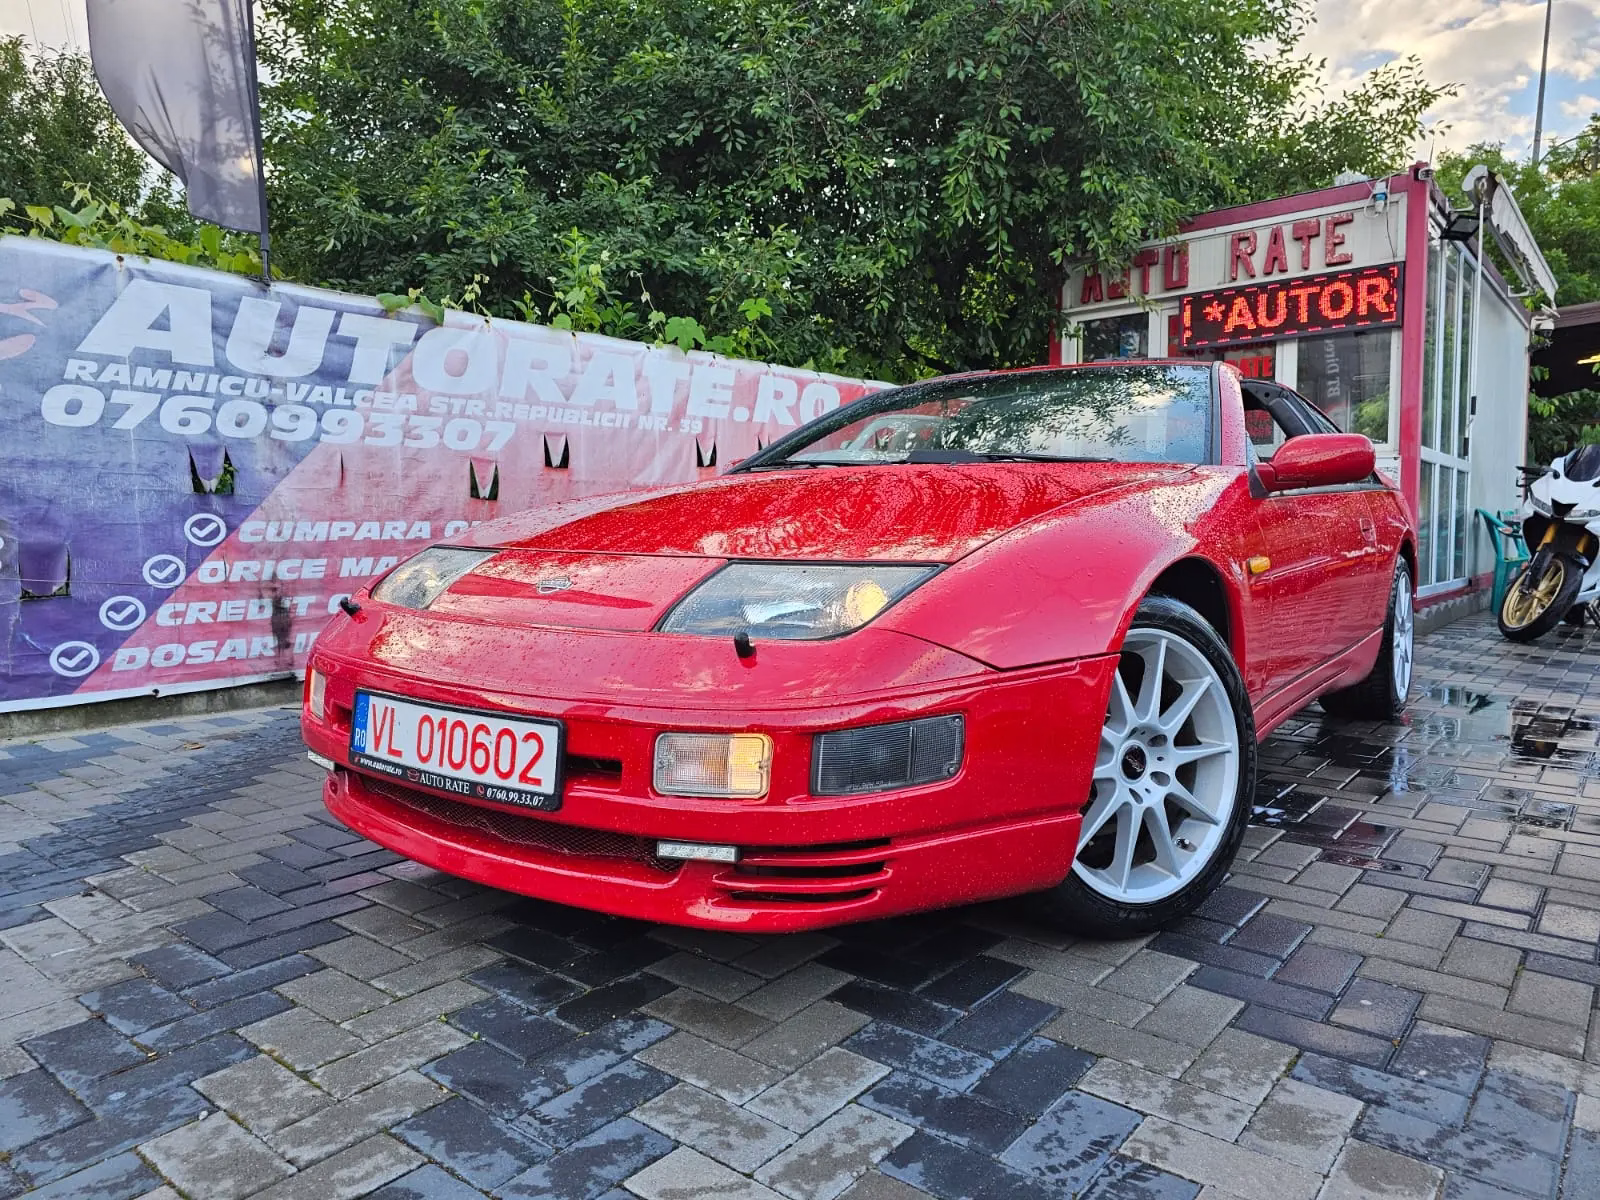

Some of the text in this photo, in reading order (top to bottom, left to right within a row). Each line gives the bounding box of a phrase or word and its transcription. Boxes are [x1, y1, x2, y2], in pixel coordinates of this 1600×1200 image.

[1230, 213, 1353, 280] RATE
[63, 358, 418, 412] RAMNICU-VALCEA
[41, 384, 516, 451] 0760993307
[238, 520, 432, 543] CUMPARA
[199, 556, 408, 584] ORICE MA
[112, 635, 276, 671] DOSAR
[354, 728, 366, 746] RO
[372, 704, 545, 787] VL 010602
[419, 773, 444, 789] AUTO
[444, 778, 470, 795] RATE
[486, 786, 544, 807] 0760.99.33.07
